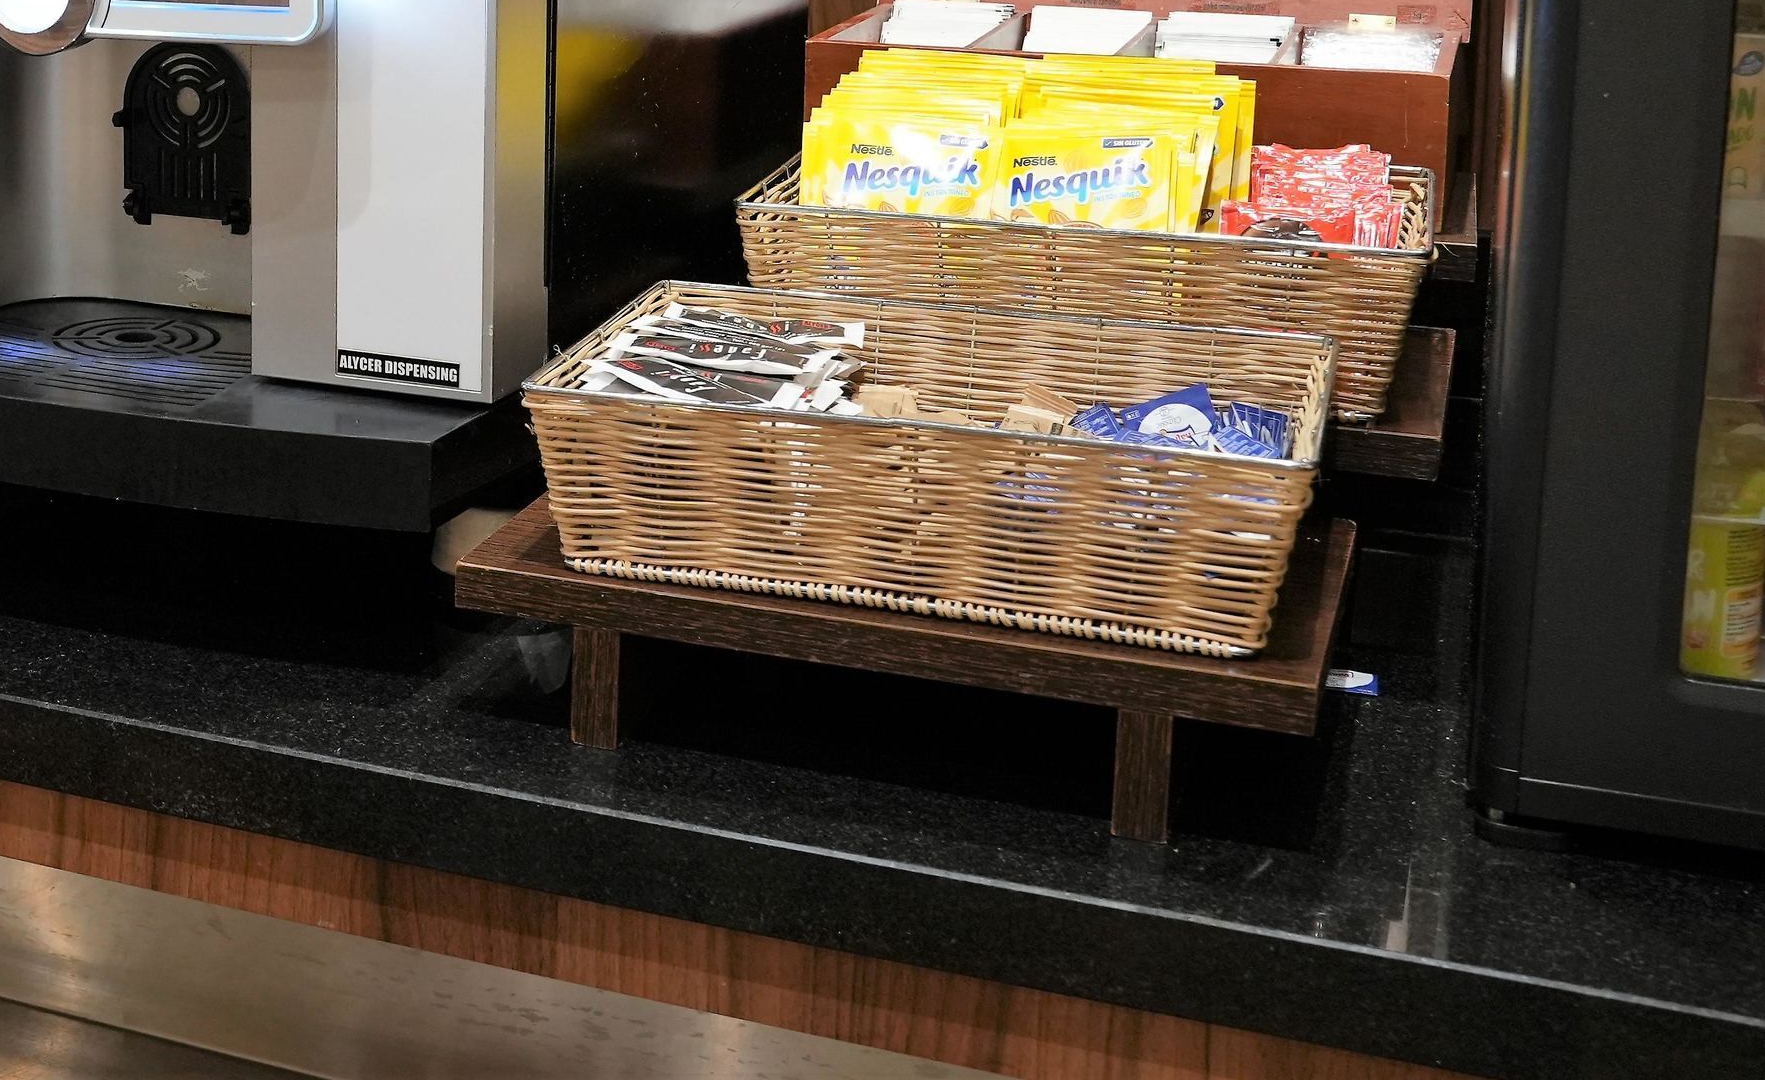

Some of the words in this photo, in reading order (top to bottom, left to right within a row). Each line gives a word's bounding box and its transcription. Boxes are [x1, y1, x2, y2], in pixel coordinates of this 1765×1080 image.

[1010, 158, 1148, 207] Nesquik
[339, 354, 383, 373] ALYCER
[384, 360, 458, 382] DISPENSING
